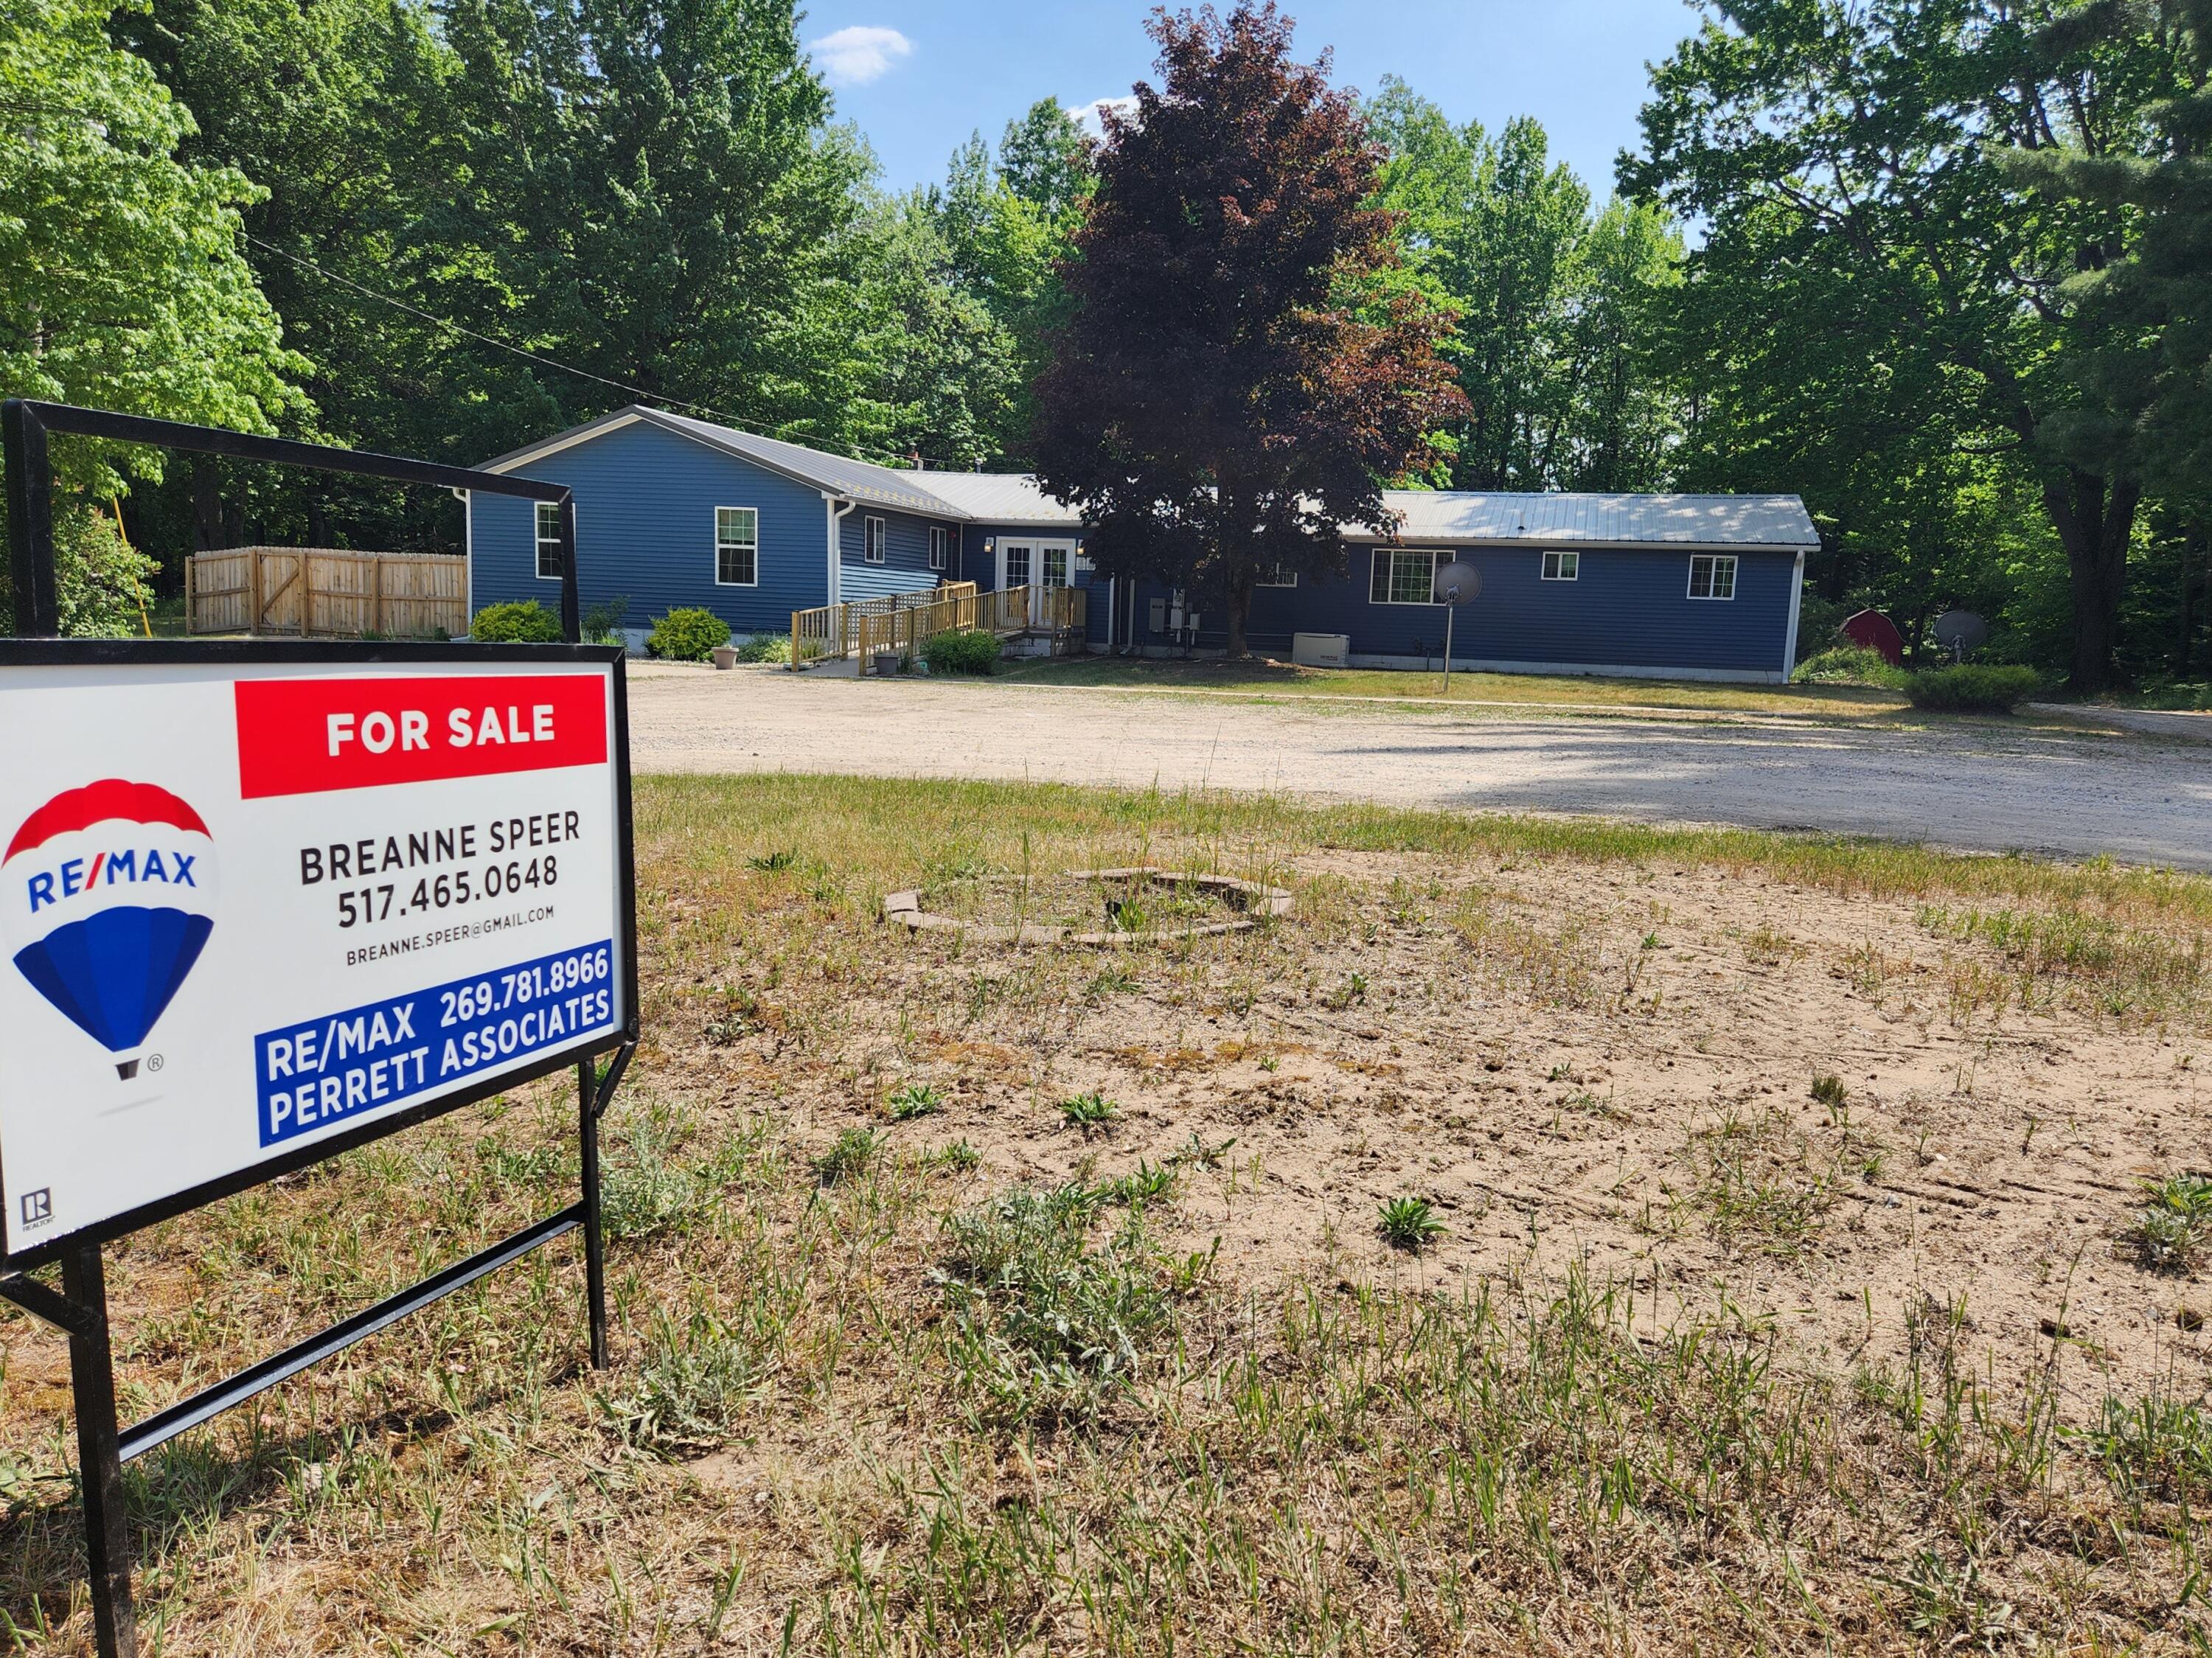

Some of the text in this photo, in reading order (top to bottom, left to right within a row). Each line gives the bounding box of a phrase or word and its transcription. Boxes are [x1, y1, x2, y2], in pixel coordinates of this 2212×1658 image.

[326, 704, 555, 757] FOR SALE
[27, 849, 197, 913] RE/MAX
[299, 810, 580, 886] BREANNE SPEER
[338, 855, 558, 928] 517.465.0648
[346, 905, 554, 966] BREANNE.SPEER@GMAIL.COM
[267, 948, 609, 1082] RE/MAX 269.781.8966
[269, 989, 610, 1136] PERRETT ASSOCIATES
